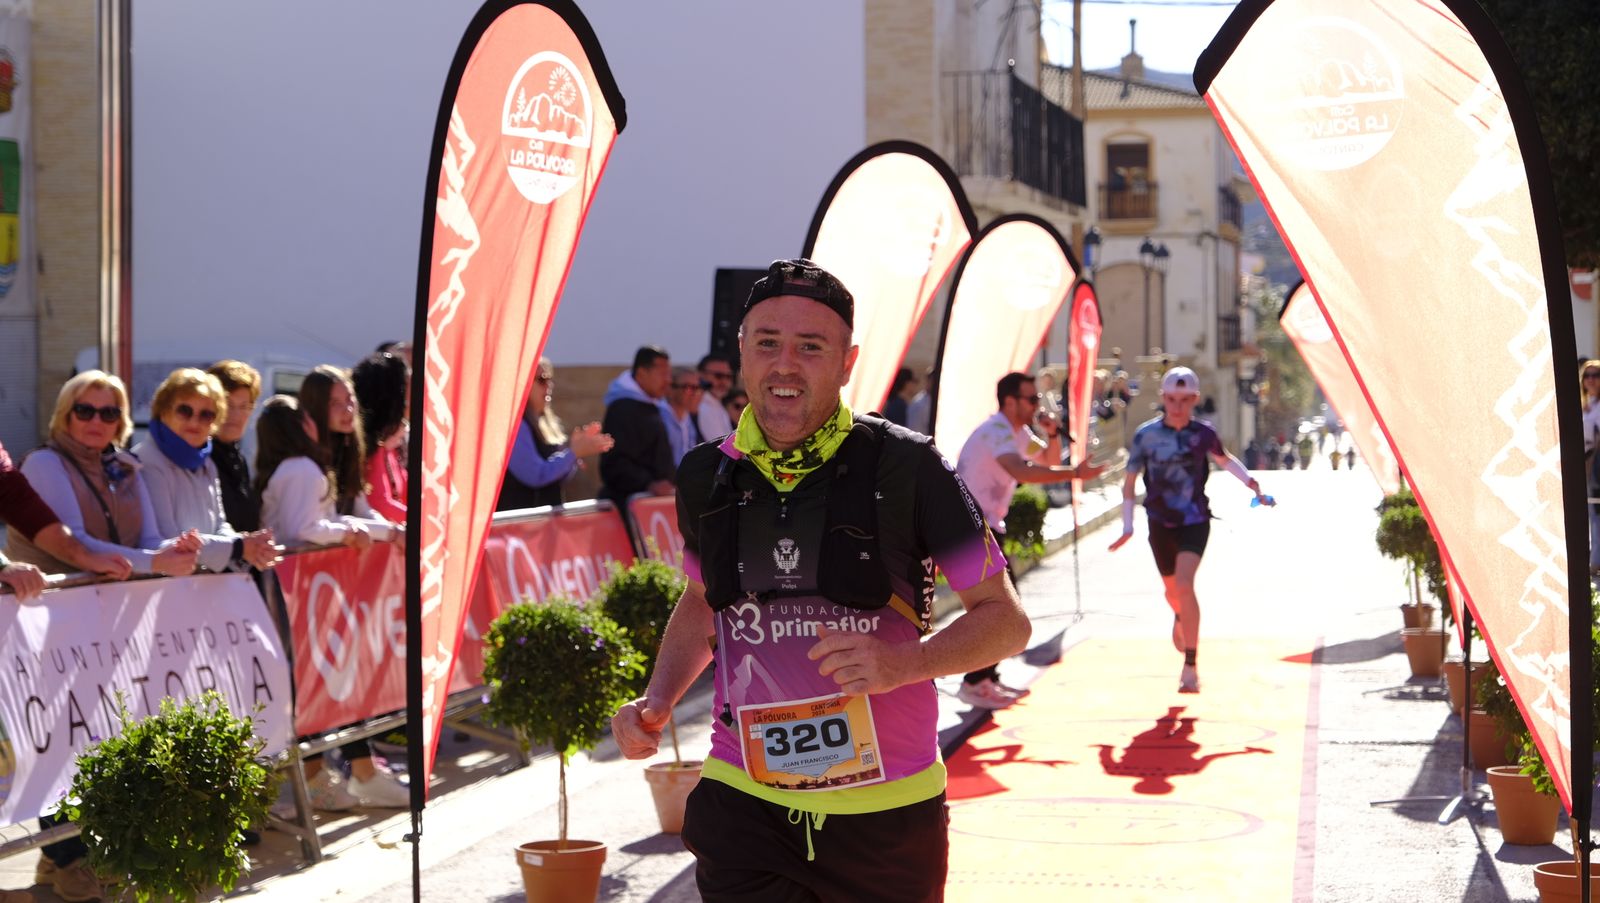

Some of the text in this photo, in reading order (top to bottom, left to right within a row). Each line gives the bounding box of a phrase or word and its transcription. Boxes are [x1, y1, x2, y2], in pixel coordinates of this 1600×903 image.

[510, 148, 525, 166] LA
[769, 604, 861, 616] FUNDACI
[770, 615, 881, 644] primaflor
[15, 619, 257, 682] AYUNTAMENTO DE
[753, 714, 763, 723] LA
[765, 717, 849, 757] 320
[781, 754, 839, 768] JUAN FRANCISCO
